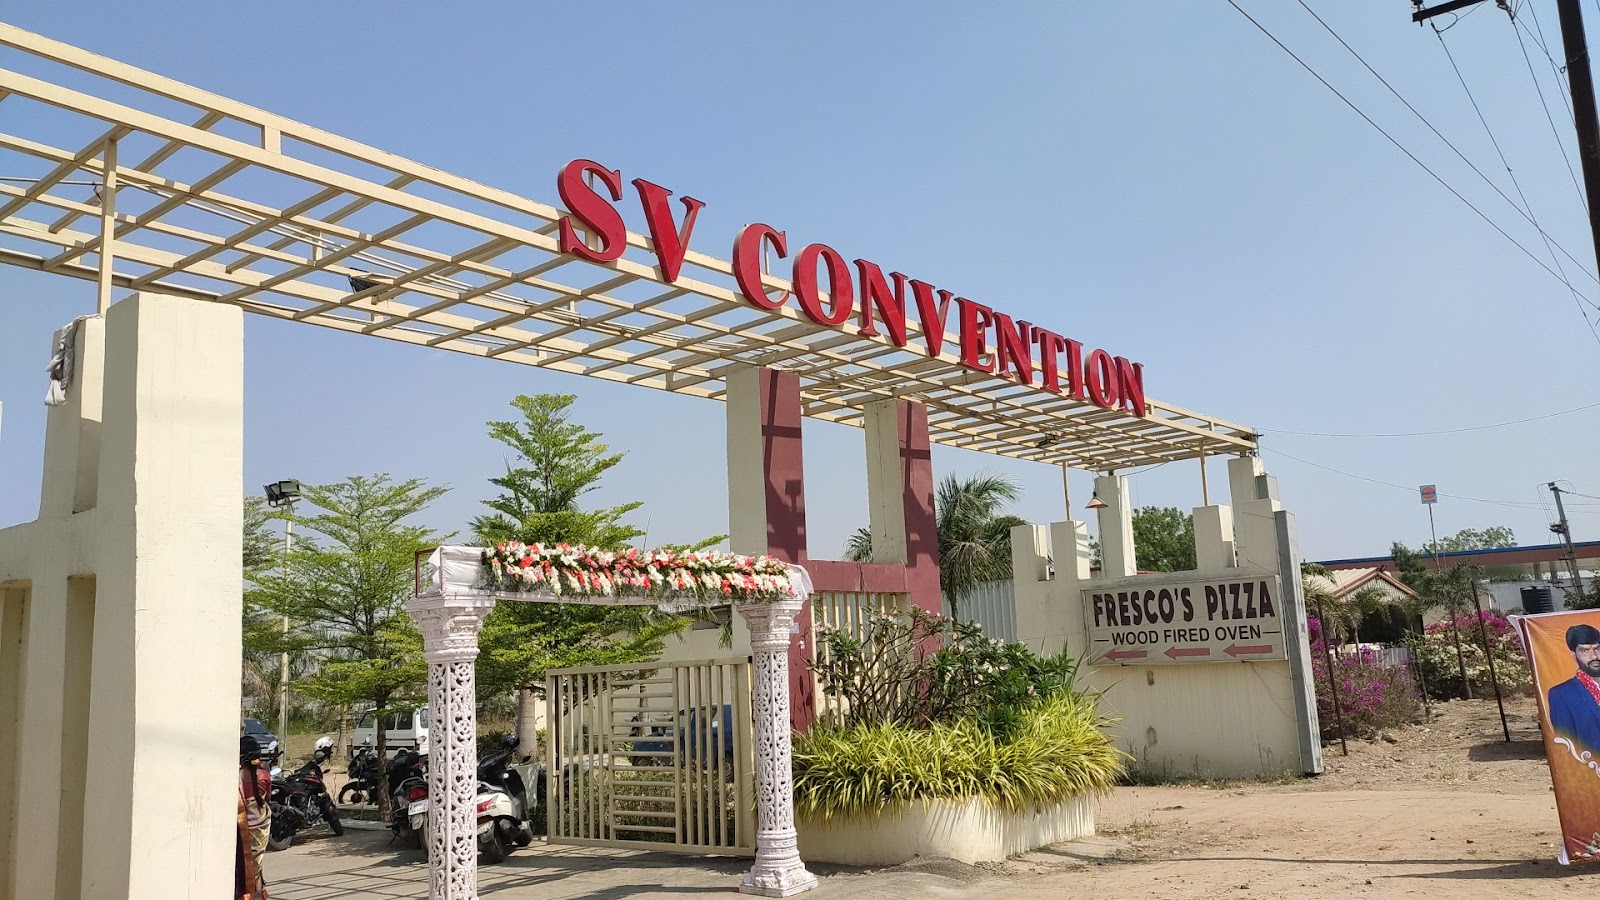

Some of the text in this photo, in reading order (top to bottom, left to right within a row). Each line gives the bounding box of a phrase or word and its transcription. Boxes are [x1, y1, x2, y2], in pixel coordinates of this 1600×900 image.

[557, 158, 1145, 416] SV CONVENTION
[1092, 581, 1276, 627] FRESCO'S PIZZA
[1111, 625, 1261, 645] WOOD FIRED OVEN
